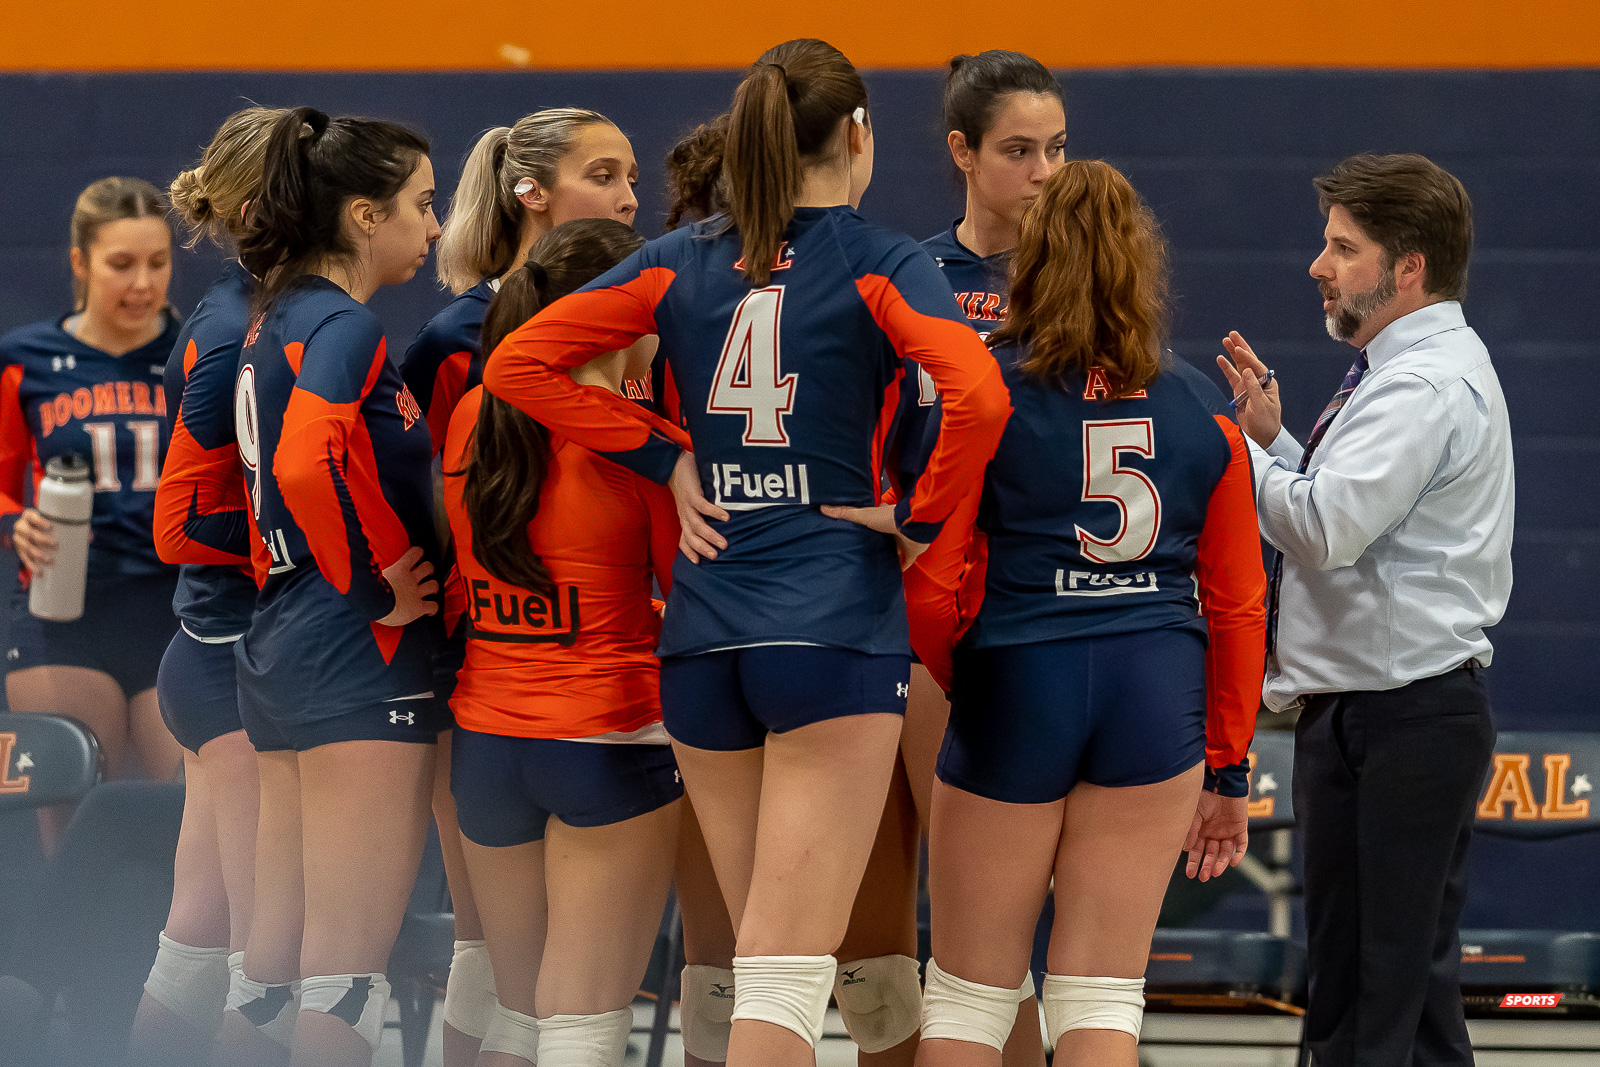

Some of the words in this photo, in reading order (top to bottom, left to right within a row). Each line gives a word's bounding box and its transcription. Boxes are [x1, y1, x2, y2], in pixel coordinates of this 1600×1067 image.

[706, 285, 799, 447] 4
[83, 421, 161, 492] 11
[235, 364, 261, 520] 9
[721, 463, 797, 499] Fuel
[1074, 417, 1161, 563] 5
[471, 579, 562, 628] Fuel
[1476, 753, 1589, 820] AL
